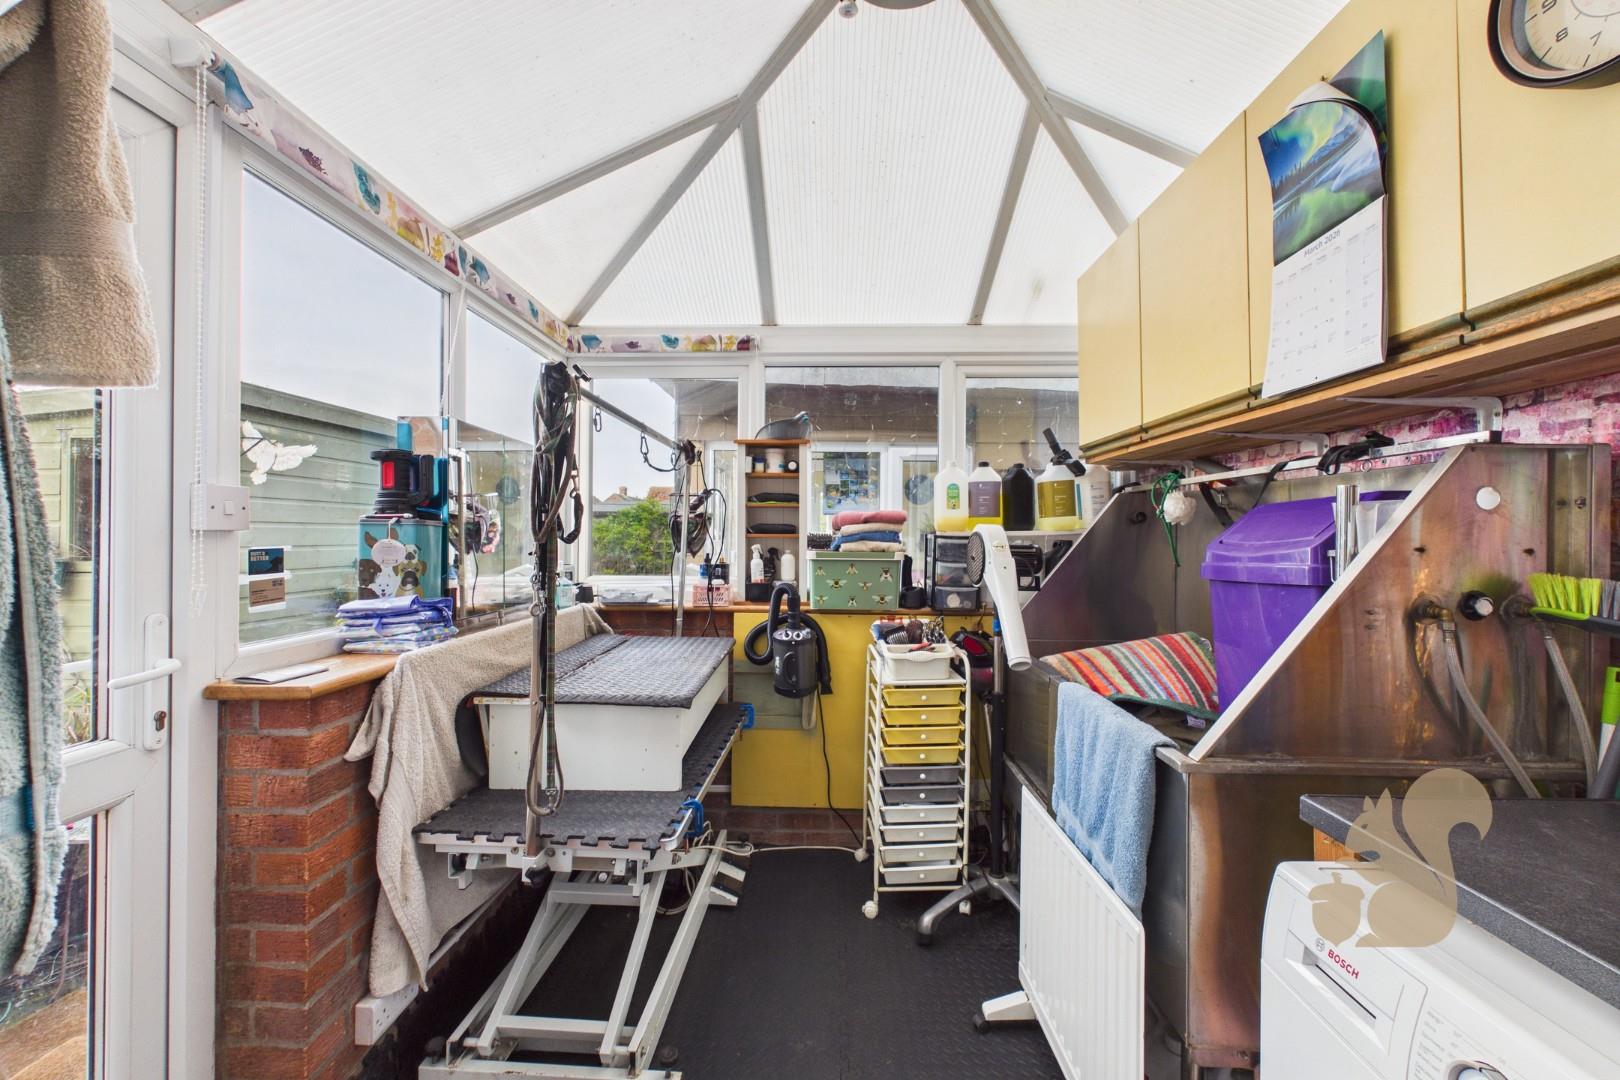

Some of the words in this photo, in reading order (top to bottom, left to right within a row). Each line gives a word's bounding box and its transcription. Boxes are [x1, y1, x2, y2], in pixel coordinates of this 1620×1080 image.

[1555, 26, 1568, 42] 8
[1590, 30, 1602, 46] 7
[1303, 240, 1323, 257] March
[1327, 948, 1360, 979] BOSCH
